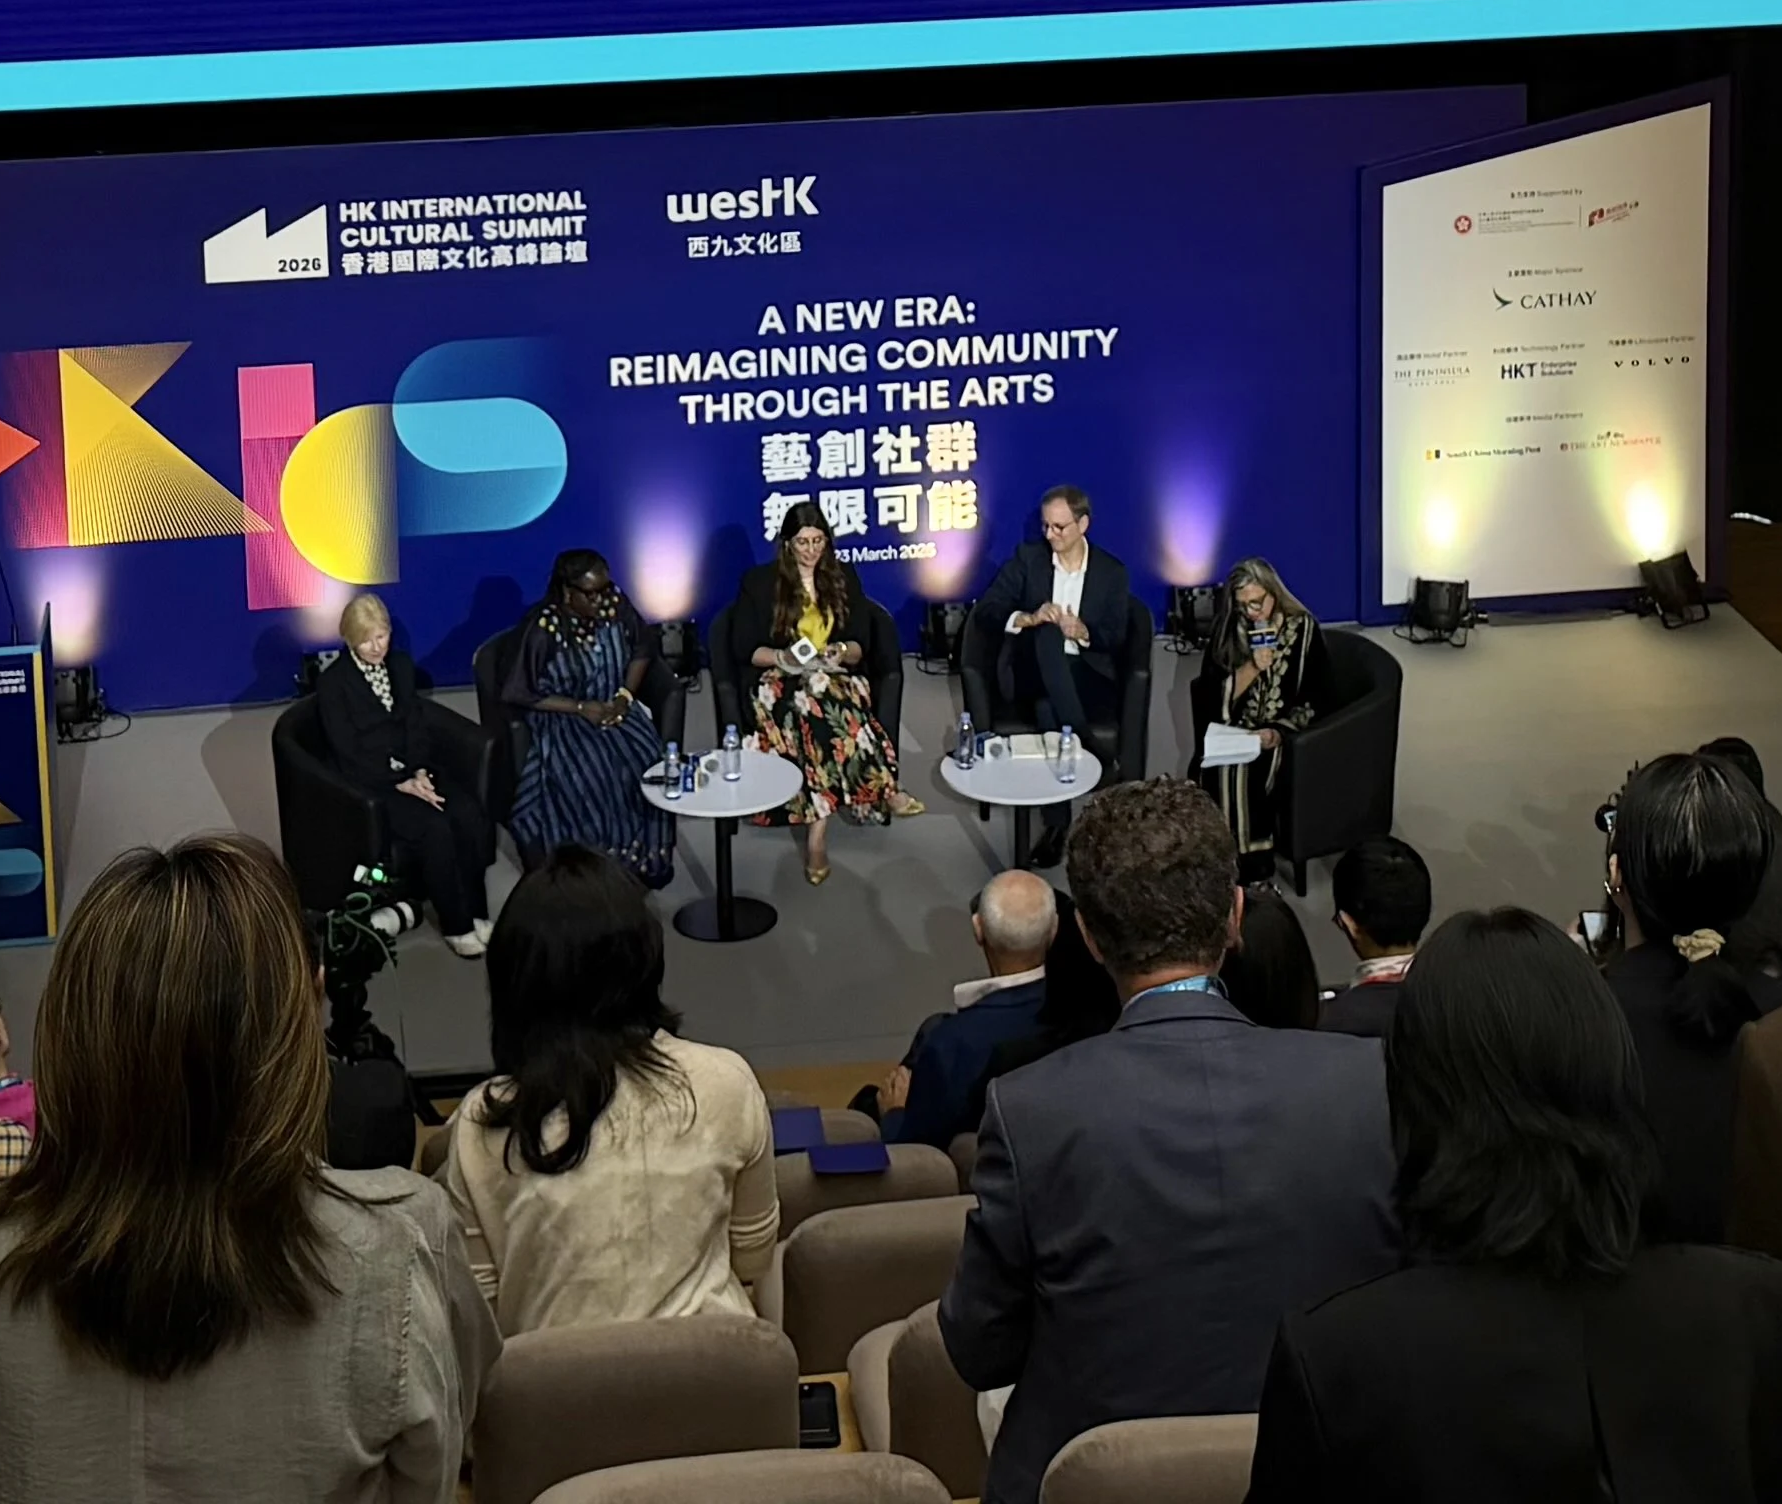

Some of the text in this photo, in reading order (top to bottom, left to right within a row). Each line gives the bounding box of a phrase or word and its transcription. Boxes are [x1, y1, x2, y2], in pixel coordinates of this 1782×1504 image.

[340, 191, 586, 222] HK INTERNATIONAL
[340, 216, 586, 247] CULTURAL SUMMIT
[687, 232, 801, 258] 西九文化區
[278, 258, 321, 272] 2026
[342, 240, 588, 275] 香港國際文化高峰論壇
[1521, 290, 1596, 309] CATHAY
[758, 296, 975, 335] A NEW ERA:
[610, 328, 1118, 386] REIMAGINING COMMUNITY
[1501, 363, 1537, 379] HKT
[1615, 356, 1690, 367] VOLVO
[679, 373, 1054, 424] THROUGH THE ARTS
[762, 421, 977, 482] 藝創社群
[852, 545, 897, 562] March
